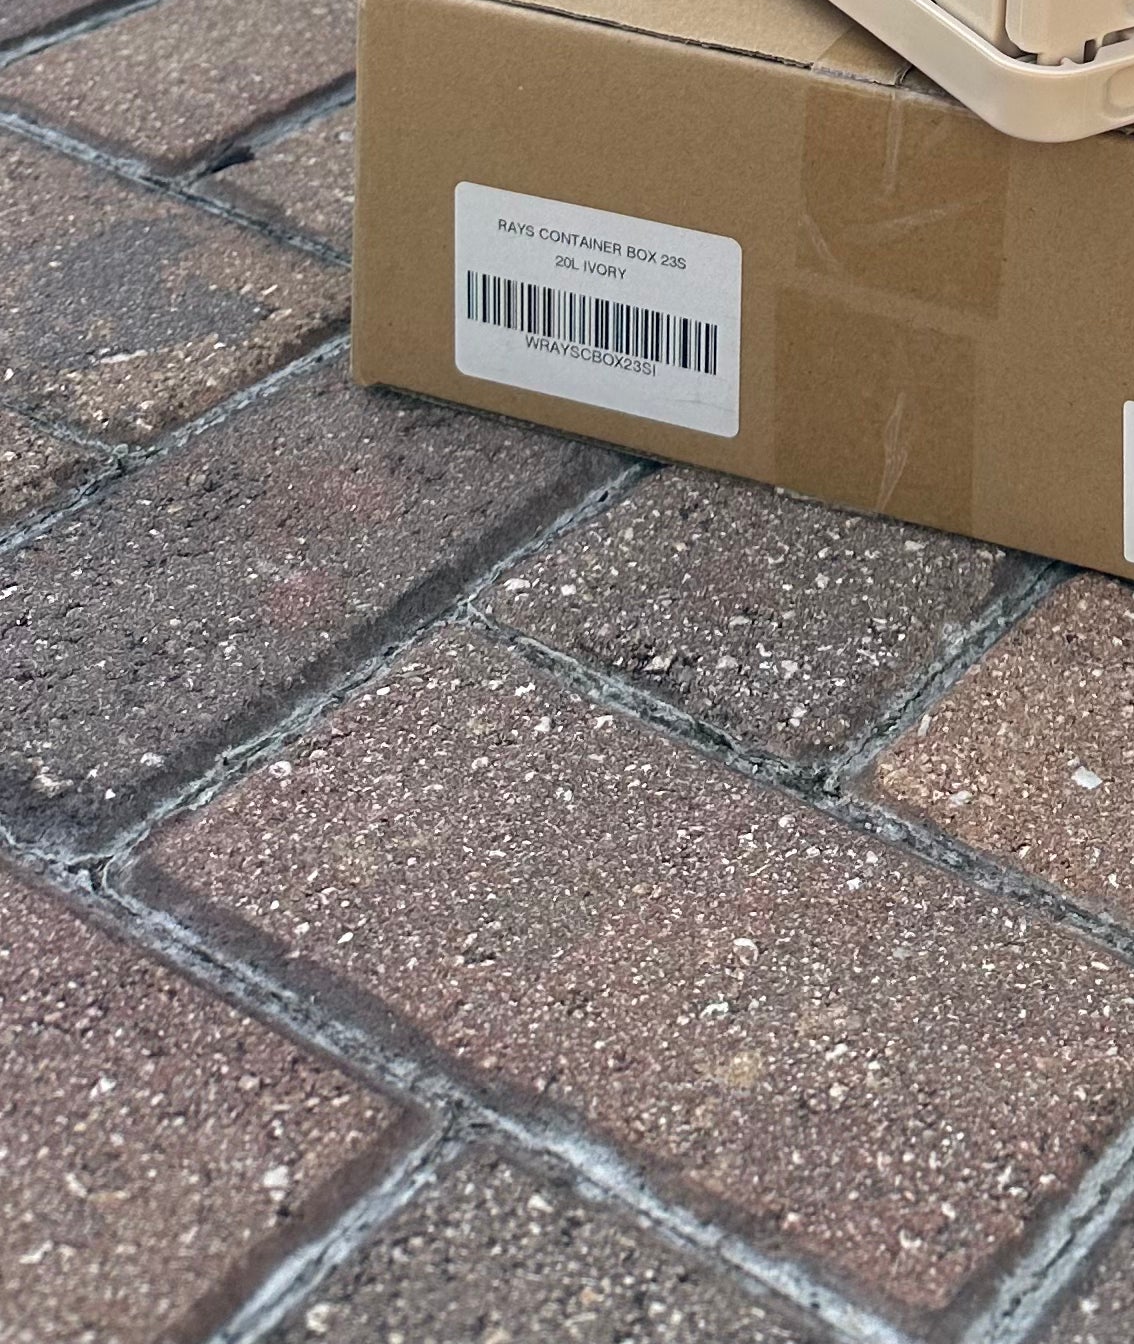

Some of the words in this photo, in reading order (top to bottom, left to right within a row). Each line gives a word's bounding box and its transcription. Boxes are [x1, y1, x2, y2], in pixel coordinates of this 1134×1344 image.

[498, 218, 535, 238] RAYS
[539, 227, 622, 257] CONTAINER
[626, 245, 657, 264] BOX
[660, 253, 687, 270] 23S
[555, 255, 580, 271] 20L
[583, 260, 627, 280] IVORY
[525, 335, 657, 377] WRAYSCBOX23SI
